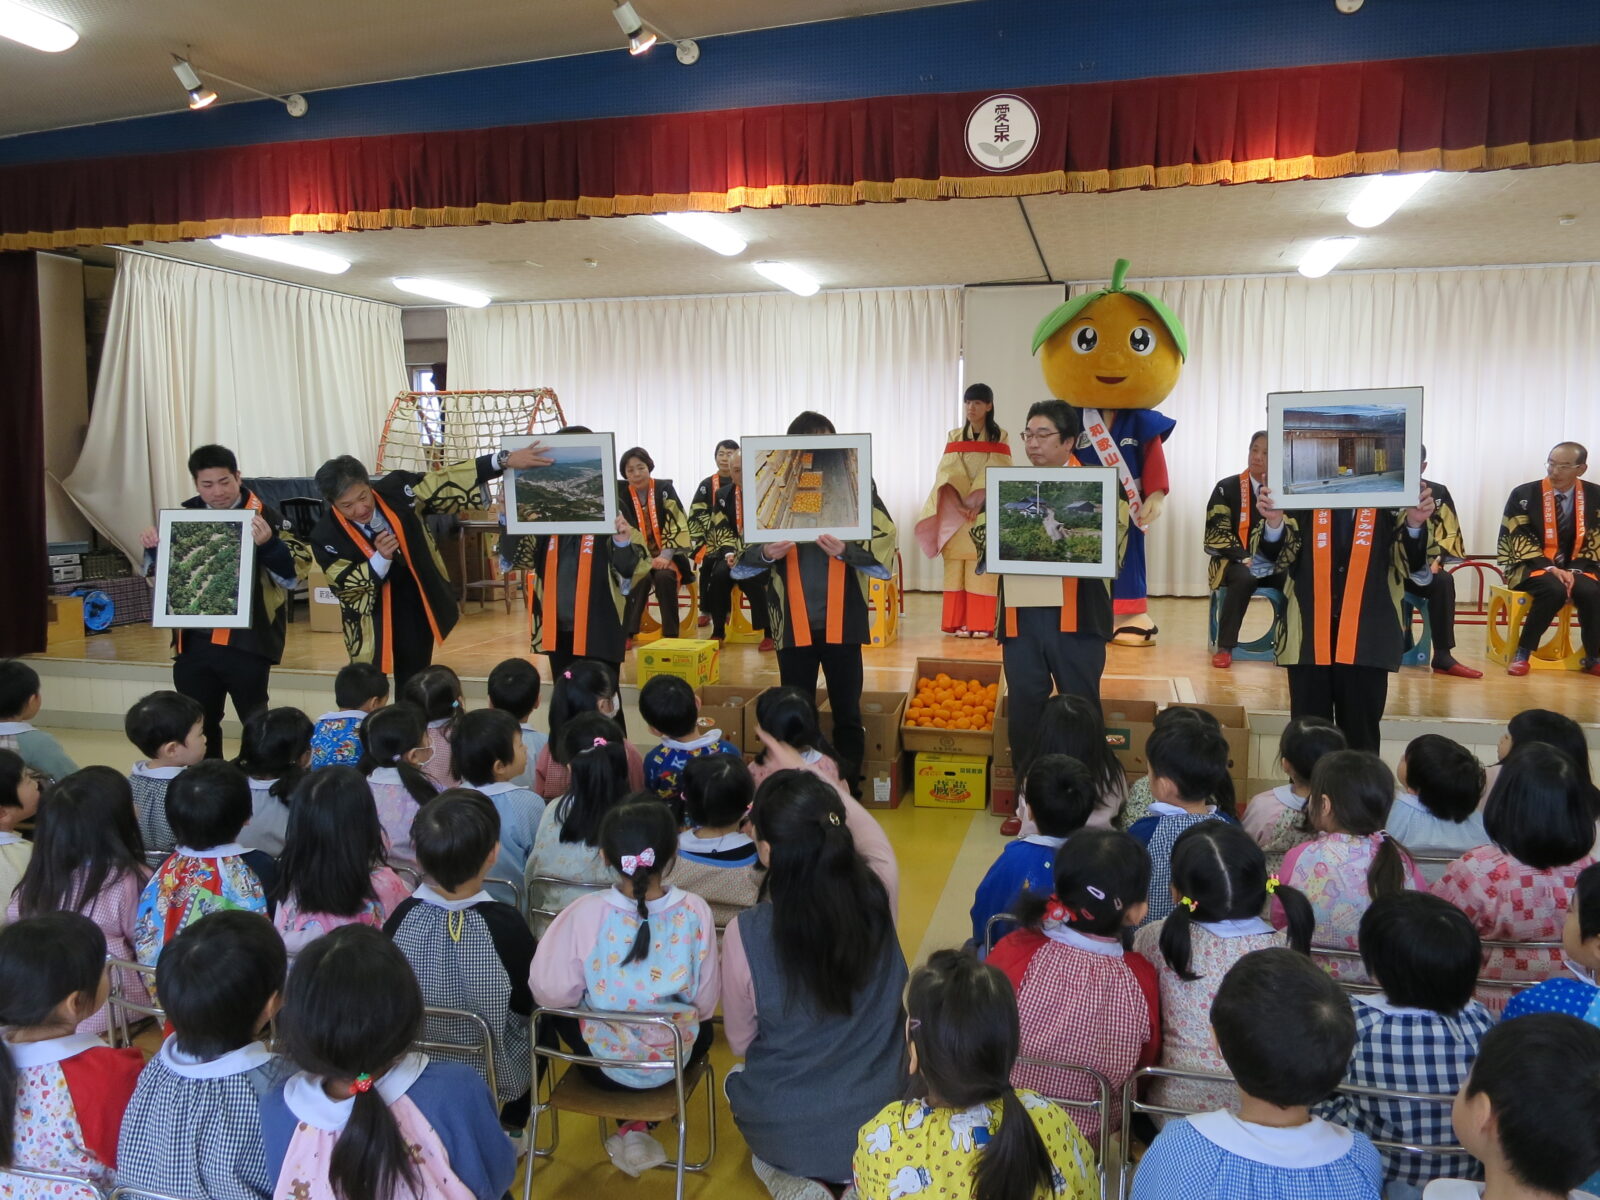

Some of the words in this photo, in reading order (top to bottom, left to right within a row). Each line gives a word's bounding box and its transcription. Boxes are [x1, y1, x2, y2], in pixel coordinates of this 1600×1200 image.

[994, 103, 1010, 143] 愛泉
[1089, 423, 1120, 467] 和歌山
